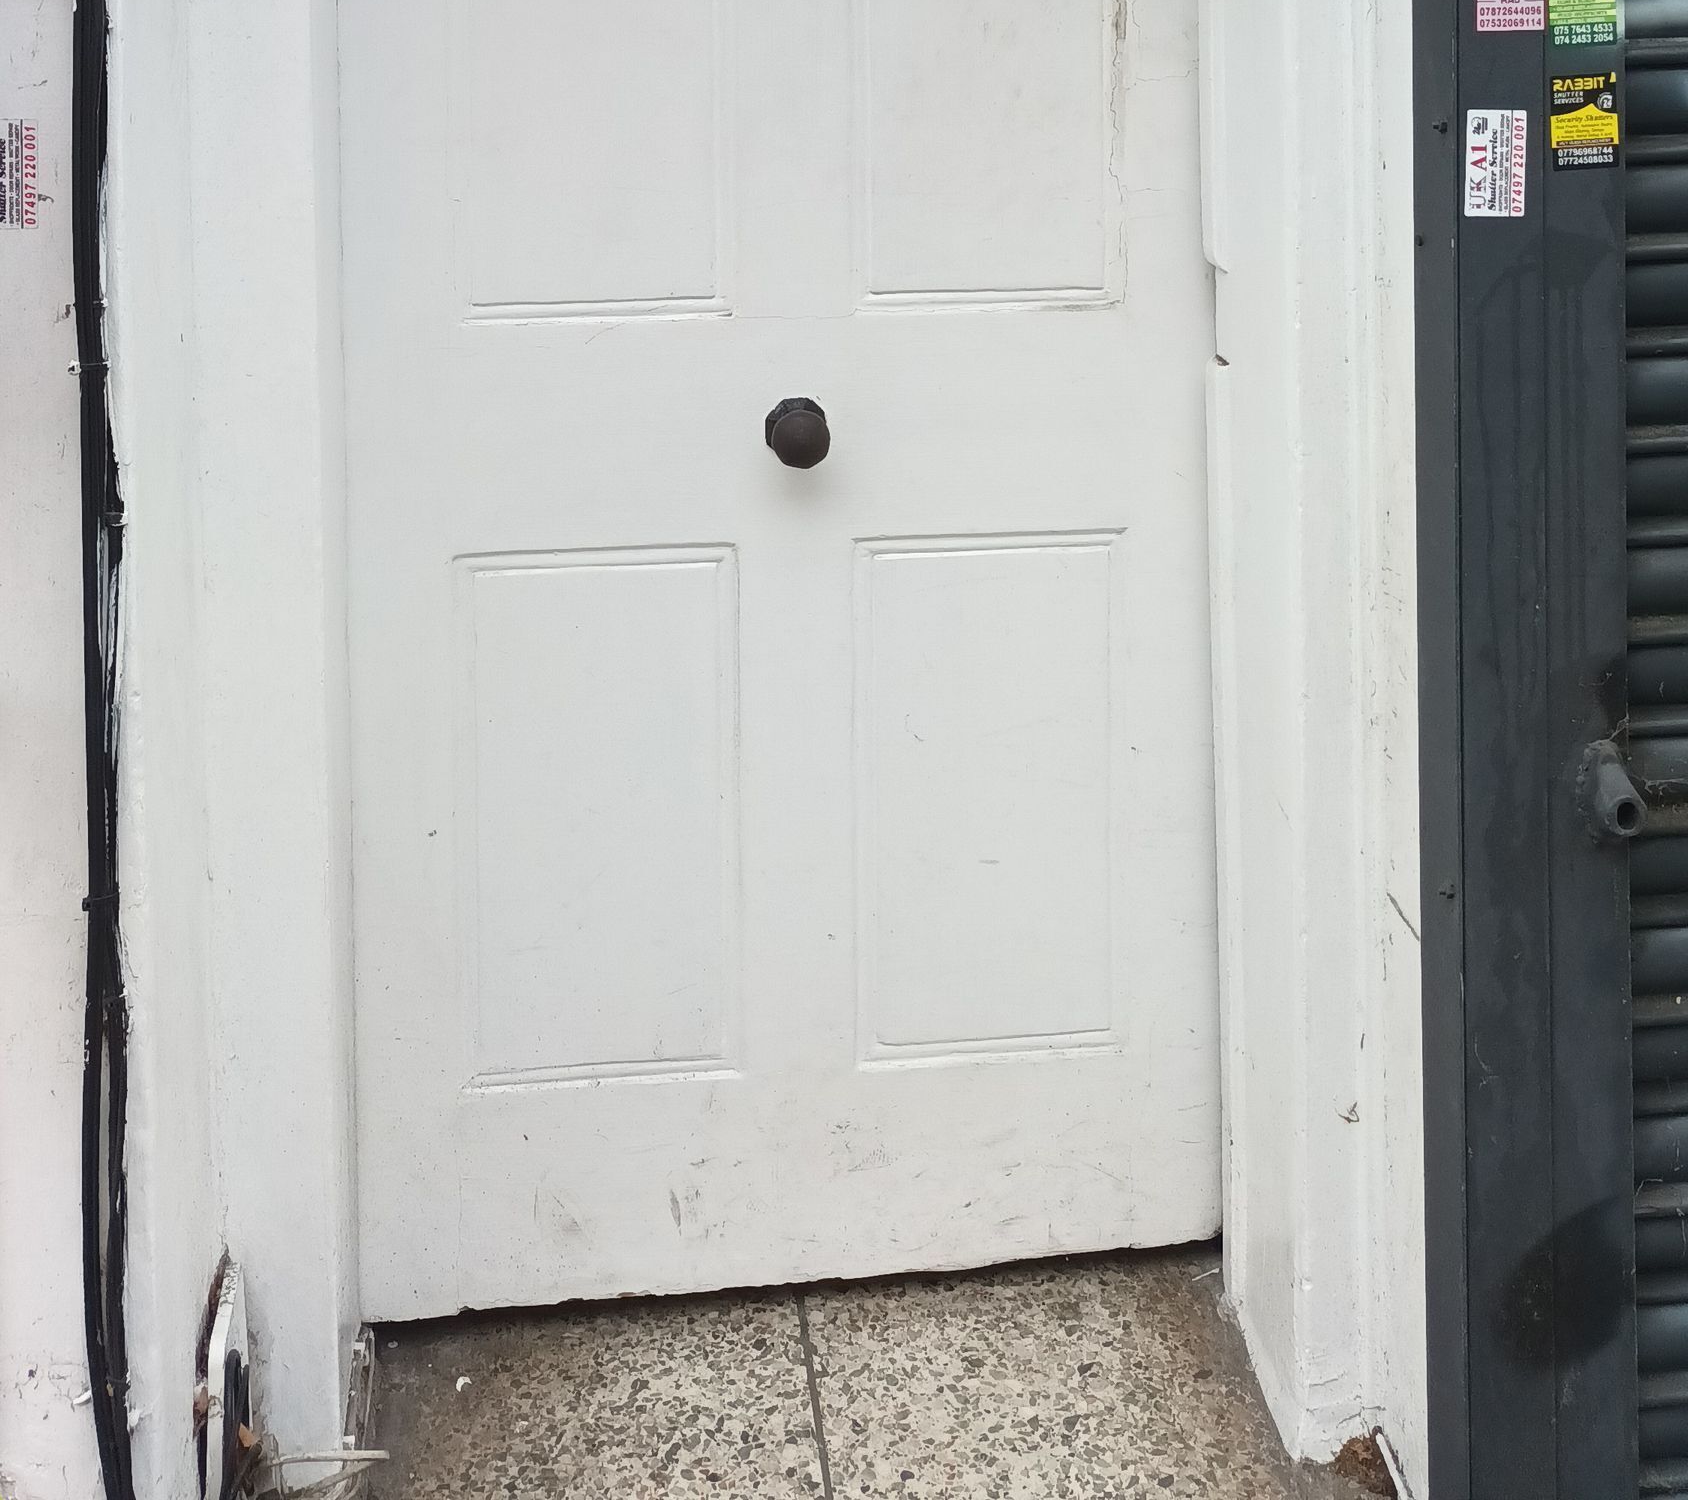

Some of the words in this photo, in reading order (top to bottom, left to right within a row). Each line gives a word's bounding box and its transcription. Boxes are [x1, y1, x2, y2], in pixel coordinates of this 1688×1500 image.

[1479, 6, 1542, 16] 07872644096
[1480, 18, 1542, 28] 07532069114
[1553, 26, 1569, 35] 075
[1571, 25, 1591, 34] 7643
[1593, 23, 1613, 32] 4533
[1554, 36, 1569, 45] 074
[1571, 34, 1592, 43] 2453
[1593, 33, 1614, 42] 2054
[1552, 77, 1605, 91] RABBIT
[24, 126, 36, 150] 001
[1514, 117, 1525, 140] 001
[1470, 145, 1488, 172] A1
[1489, 128, 1498, 168] Service
[1513, 145, 1524, 168] 220
[25, 155, 36, 179] 220
[1469, 176, 1487, 210] UK
[1487, 170, 1497, 211] Shutter
[1512, 173, 1523, 213] 07497
[25, 183, 36, 225] 07497
